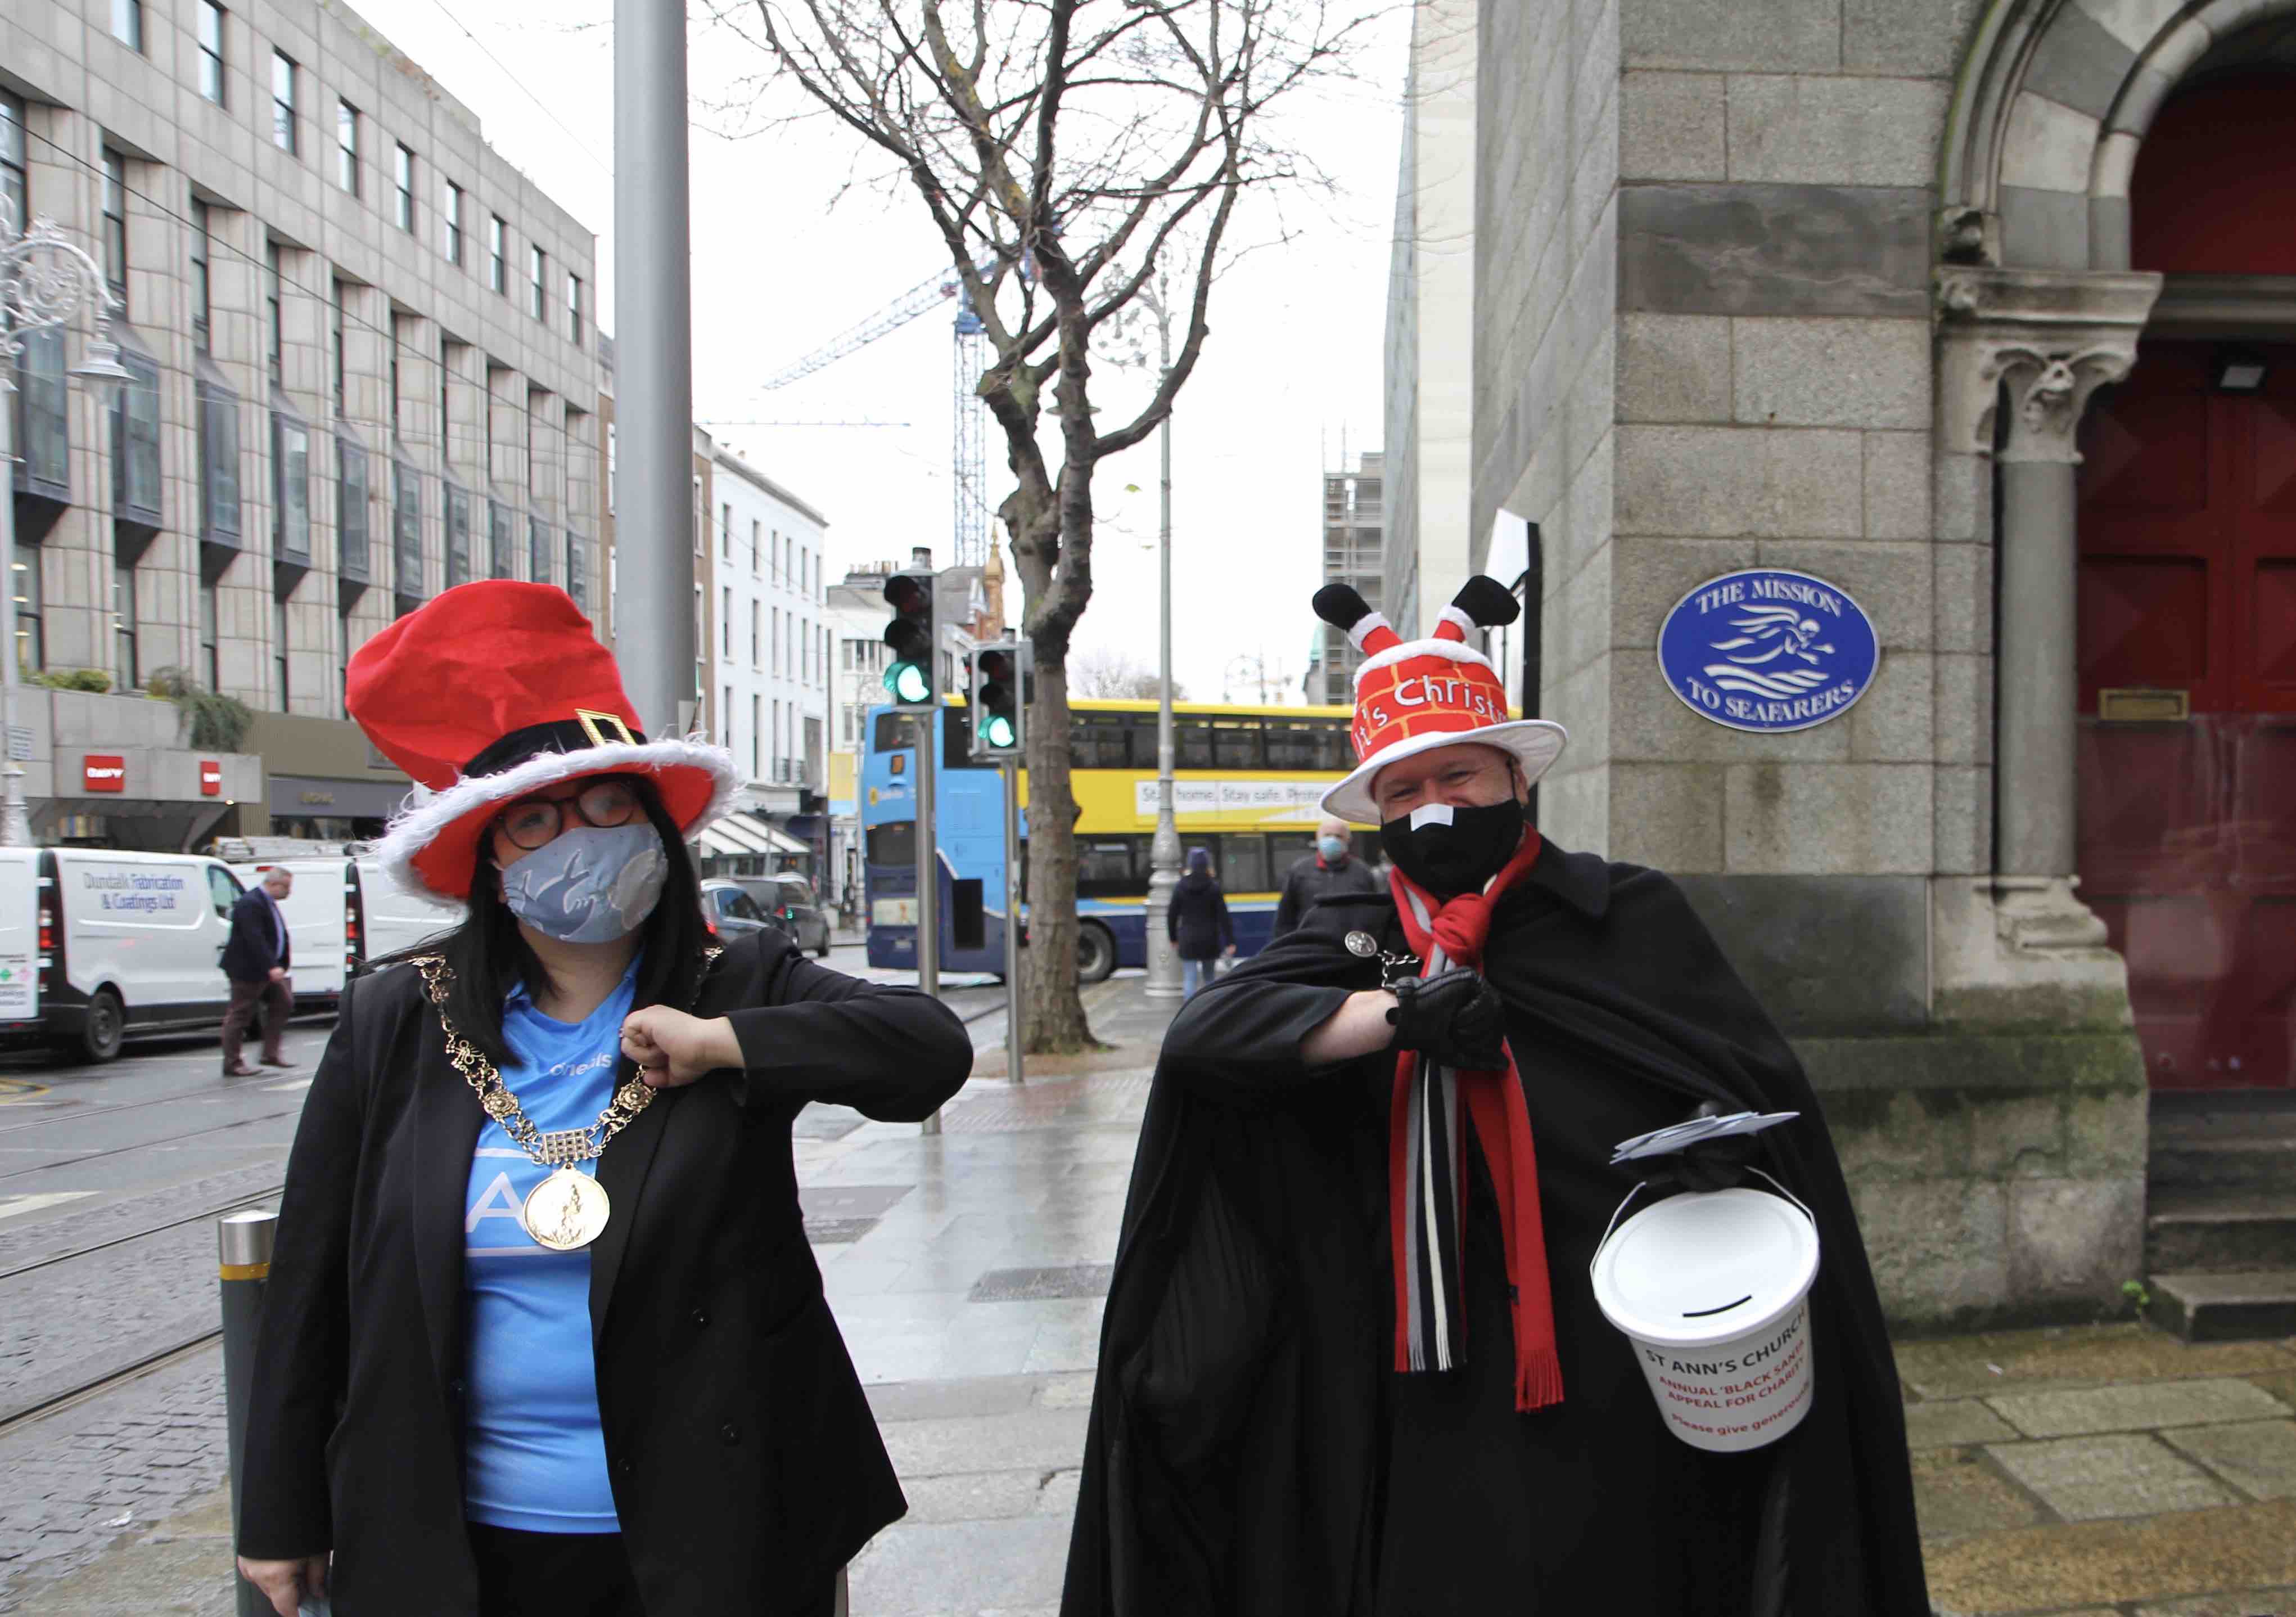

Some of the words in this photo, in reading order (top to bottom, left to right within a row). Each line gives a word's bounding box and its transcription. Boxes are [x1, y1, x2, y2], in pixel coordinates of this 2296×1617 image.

[1695, 581, 1745, 615] THE
[1752, 578, 1843, 618] MISSION
[1686, 677, 1721, 710] TO
[1725, 679, 1856, 722] SEAFARERS
[1354, 706, 1388, 758] It's
[1222, 787, 1251, 804] Stay
[1286, 787, 1323, 803] Prote
[83, 872, 129, 890] Dundalk
[130, 873, 184, 890] Fabrication
[101, 893, 111, 909] &
[113, 893, 158, 914] Coatings
[160, 893, 176, 909] Ltd
[465, 1171, 528, 1233] A
[1646, 1349, 1665, 1367] ST
[1672, 1359, 1738, 1375] ANN'S
[1742, 1305, 1805, 1367] CHURCH
[1659, 1376, 1718, 1395] ANNUAL
[1668, 1390, 1721, 1408] APPEAL
[1726, 1394, 1756, 1407] FOR
[1758, 1356, 1803, 1398] CHARITY
[1672, 1413, 1713, 1434] Please
[1717, 1425, 1748, 1435] give
